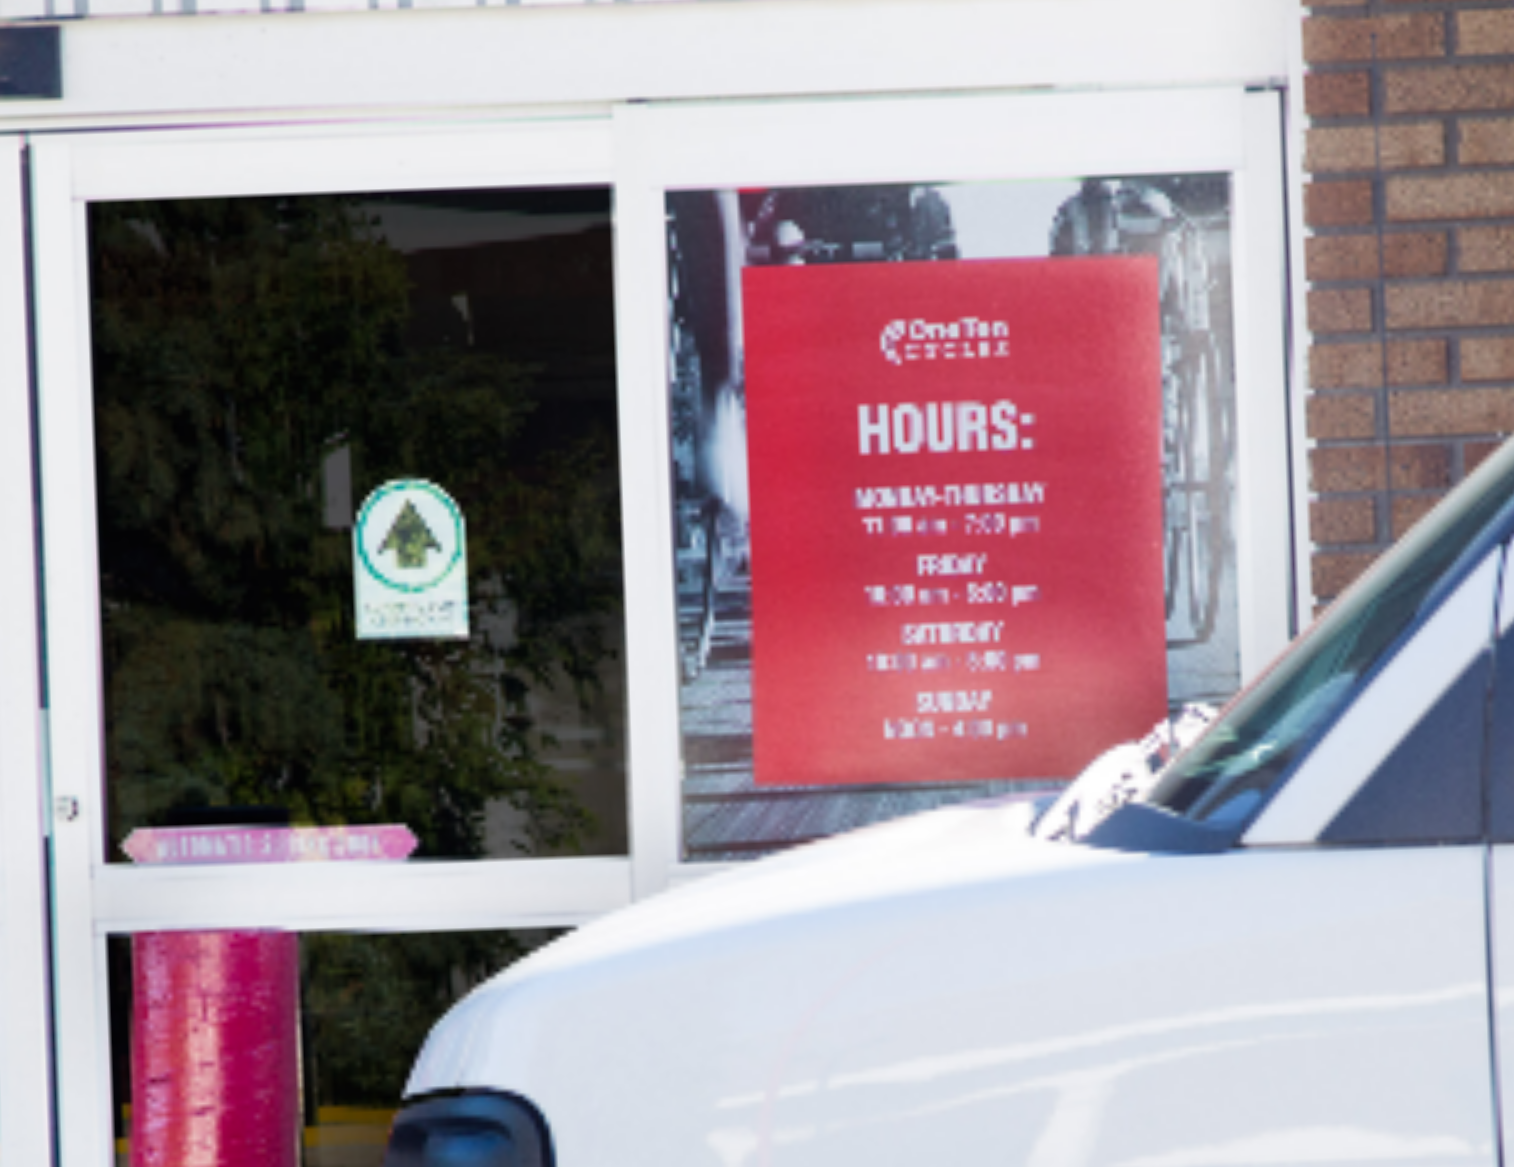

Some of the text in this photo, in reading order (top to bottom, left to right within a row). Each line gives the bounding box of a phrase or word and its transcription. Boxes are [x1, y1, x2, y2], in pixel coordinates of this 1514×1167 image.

[857, 398, 1035, 455] HOURS:
[917, 552, 988, 577] FRIDAY
[902, 620, 1005, 645] SATURDAY
